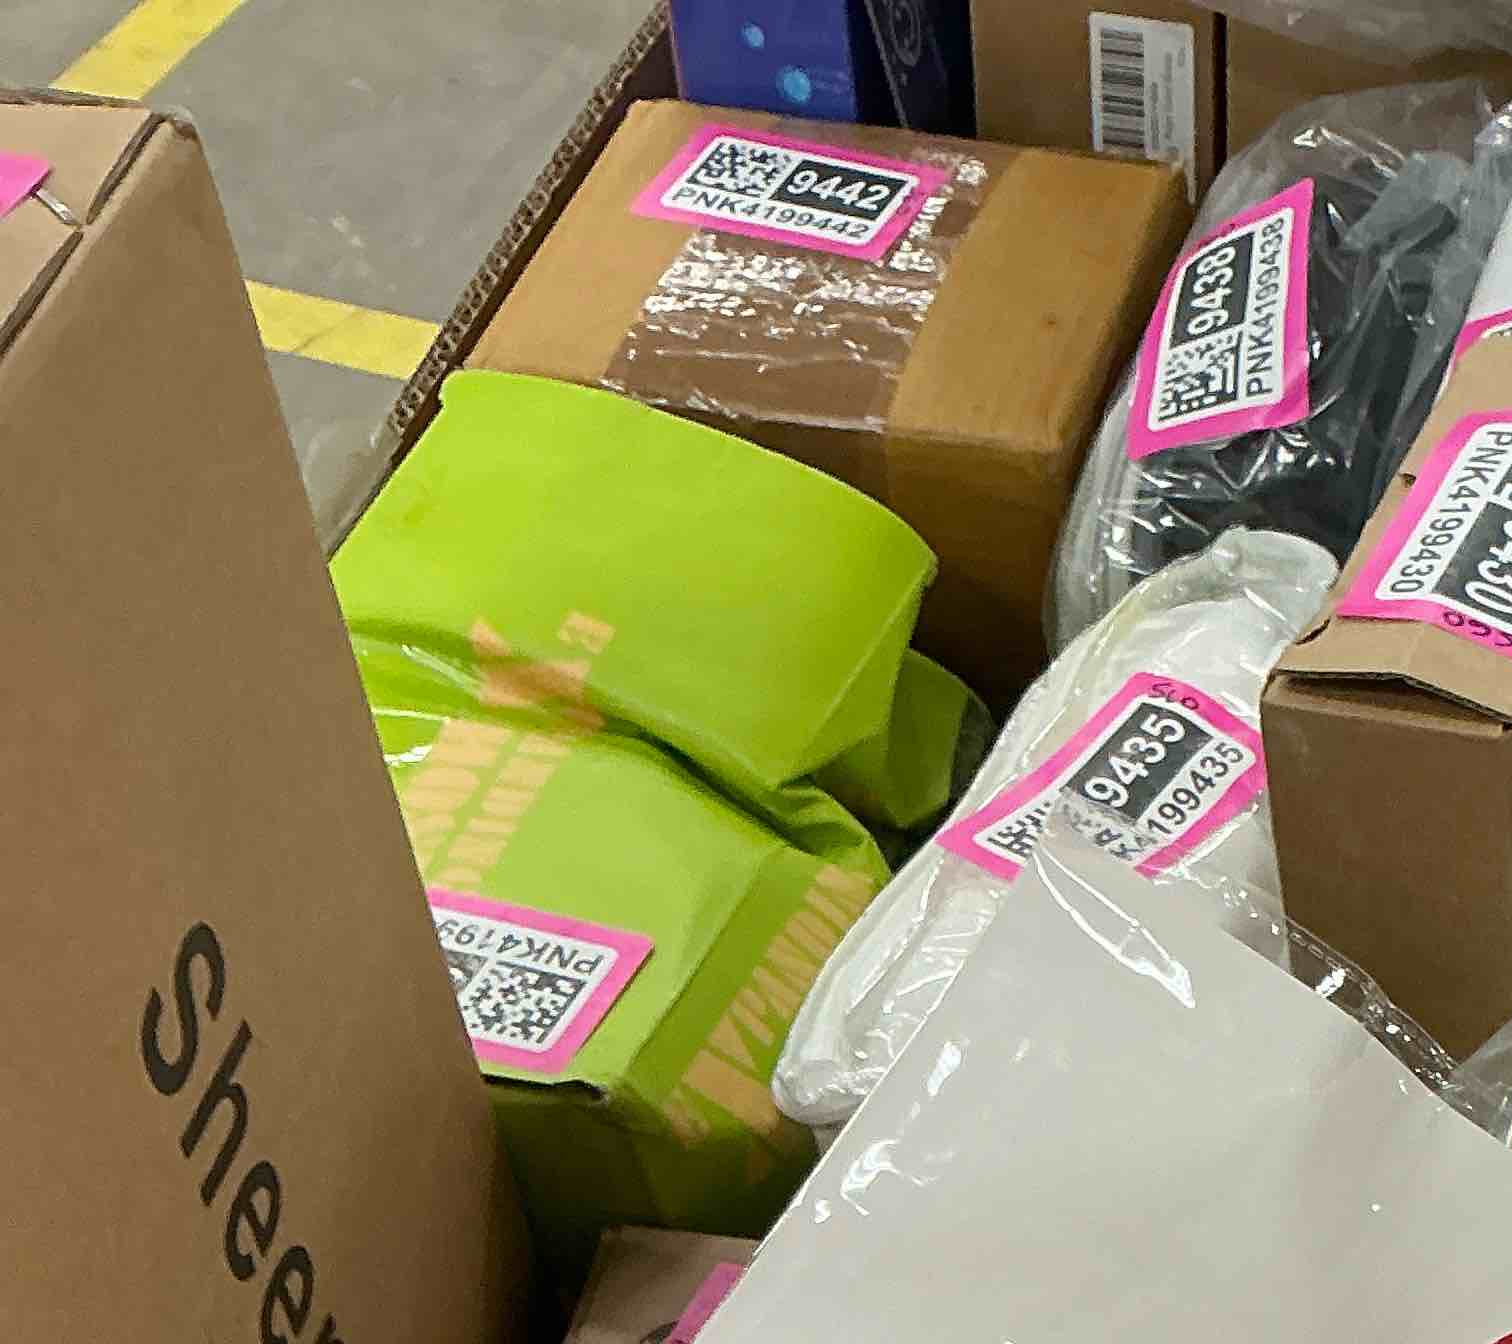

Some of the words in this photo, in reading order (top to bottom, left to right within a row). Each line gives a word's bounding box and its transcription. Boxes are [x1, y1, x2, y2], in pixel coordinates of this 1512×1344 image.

[671, 185, 870, 238] PNK4199442
[785, 169, 891, 211] 9442
[1186, 245, 1237, 336] 9438
[1245, 216, 1285, 398] PNK4199438
[1082, 713, 1187, 810] 9435
